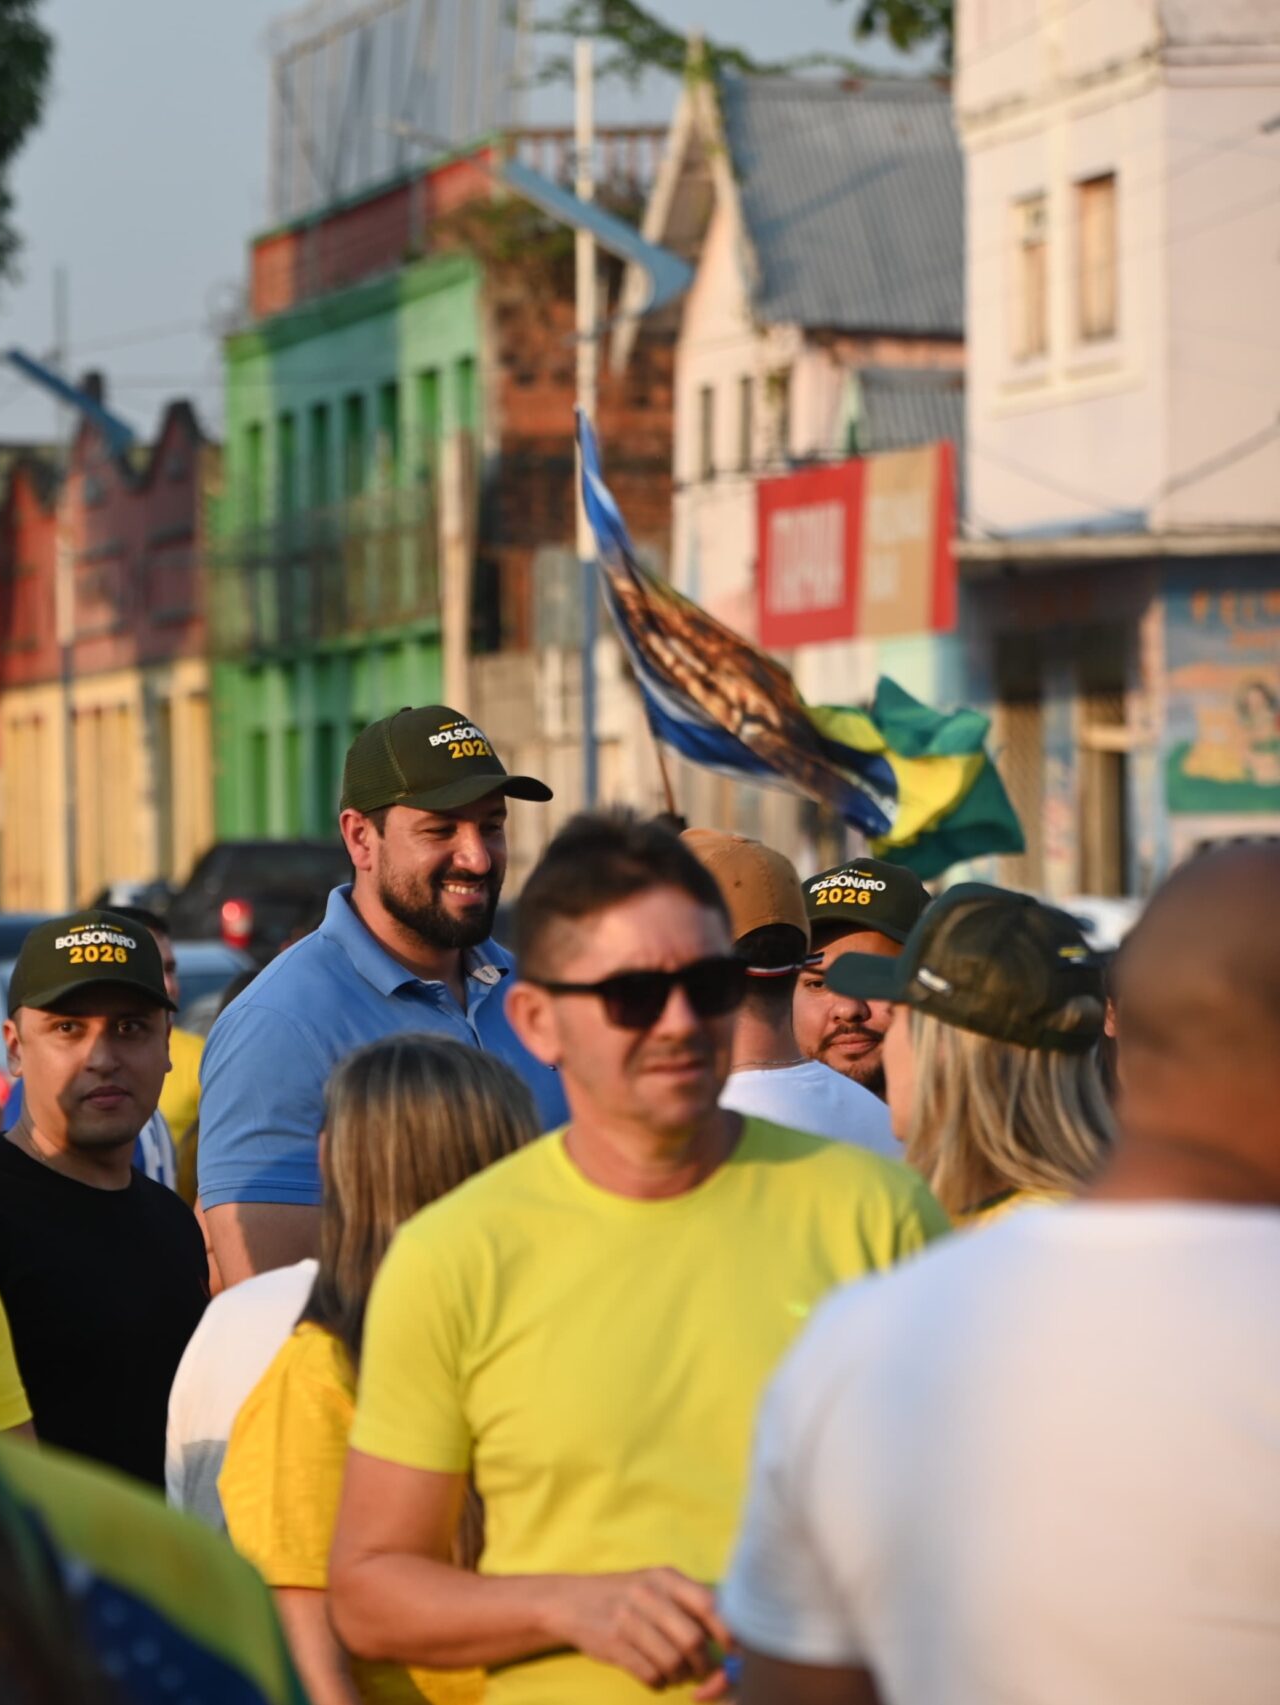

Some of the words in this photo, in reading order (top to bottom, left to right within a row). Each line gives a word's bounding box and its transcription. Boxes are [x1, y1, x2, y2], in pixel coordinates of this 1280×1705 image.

[428, 727, 488, 747] BOLSON
[809, 875, 886, 893] BOLSONARO
[816, 887, 871, 906] 2026
[55, 931, 137, 949] BOLSONARO
[69, 944, 127, 964] 2026
